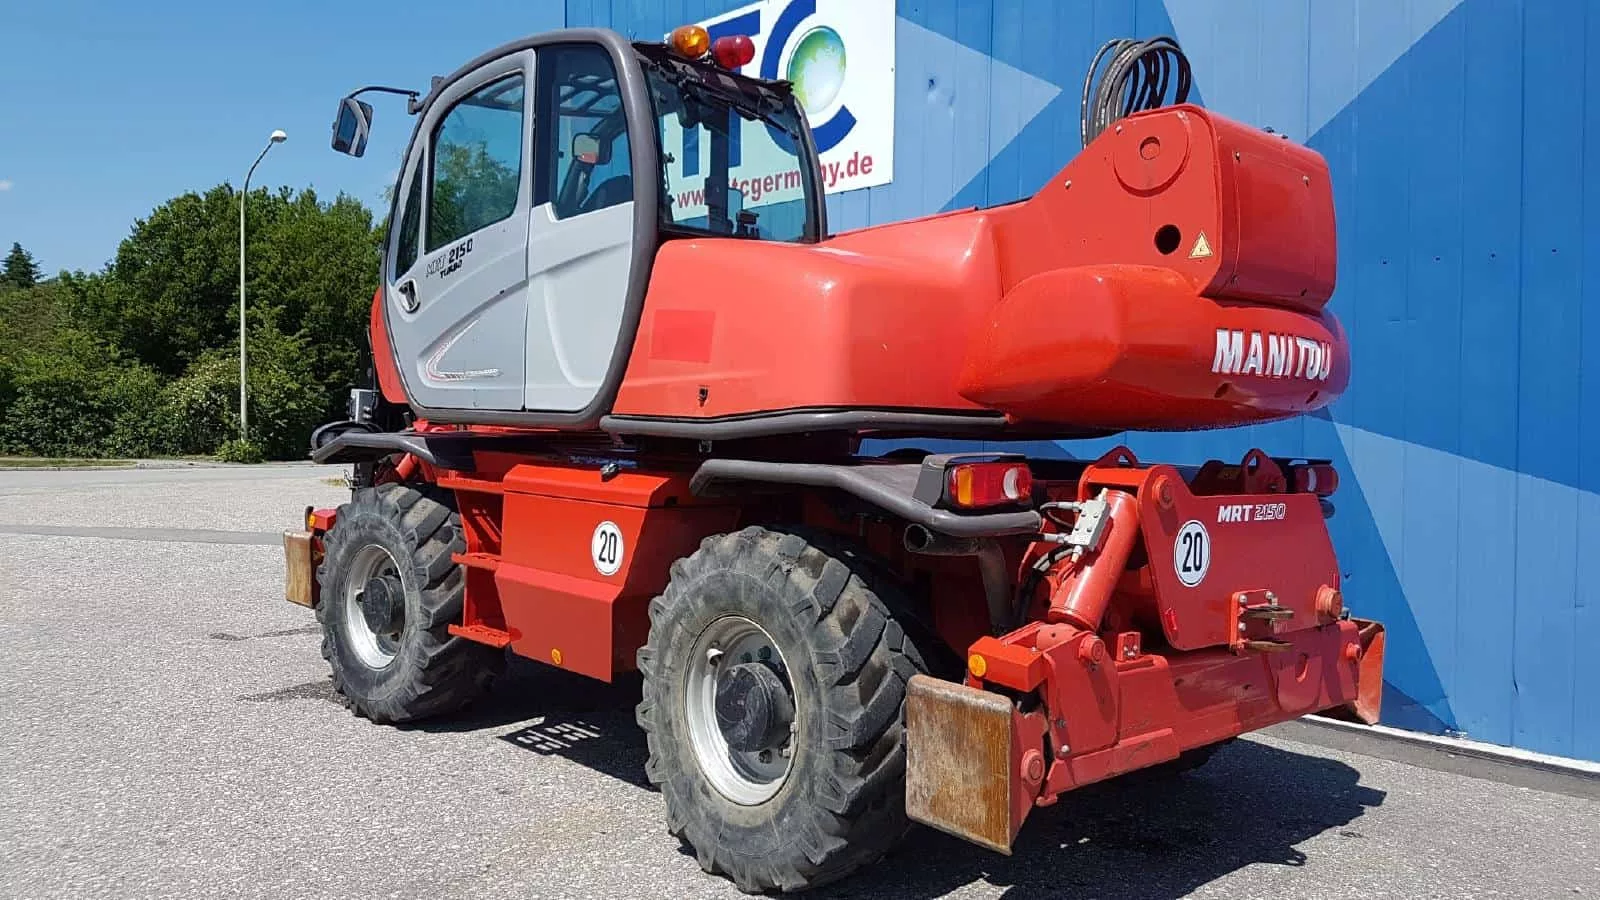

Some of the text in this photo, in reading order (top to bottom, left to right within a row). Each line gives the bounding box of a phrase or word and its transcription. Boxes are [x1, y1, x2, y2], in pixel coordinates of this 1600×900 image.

[677, 151, 874, 209] wwtcgermny.de
[448, 238, 473, 264] 2150
[1211, 328, 1332, 382] MANITOU
[1217, 502, 1286, 523] MRT 2150
[598, 529, 618, 565] 20
[1182, 531, 1203, 573] 20
